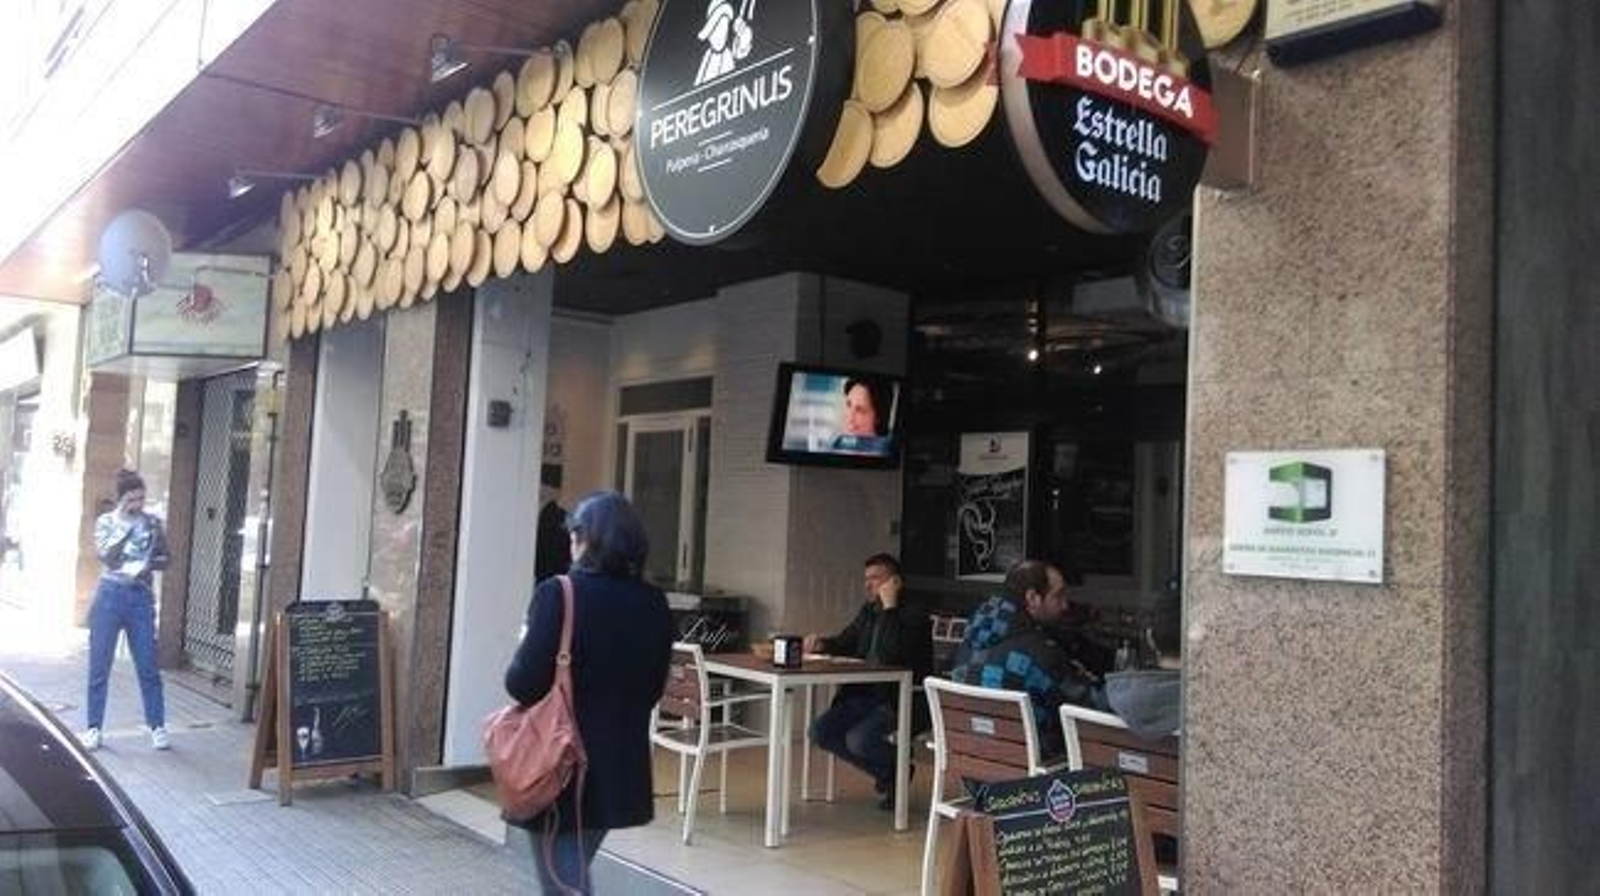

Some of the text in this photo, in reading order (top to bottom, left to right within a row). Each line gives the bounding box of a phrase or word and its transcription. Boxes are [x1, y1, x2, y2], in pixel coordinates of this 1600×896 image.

[651, 65, 793, 149] PEREGRINUS
[1076, 44, 1193, 118] BODEGA
[1073, 95, 1167, 162] Estrella
[1075, 141, 1161, 203] Galicia
